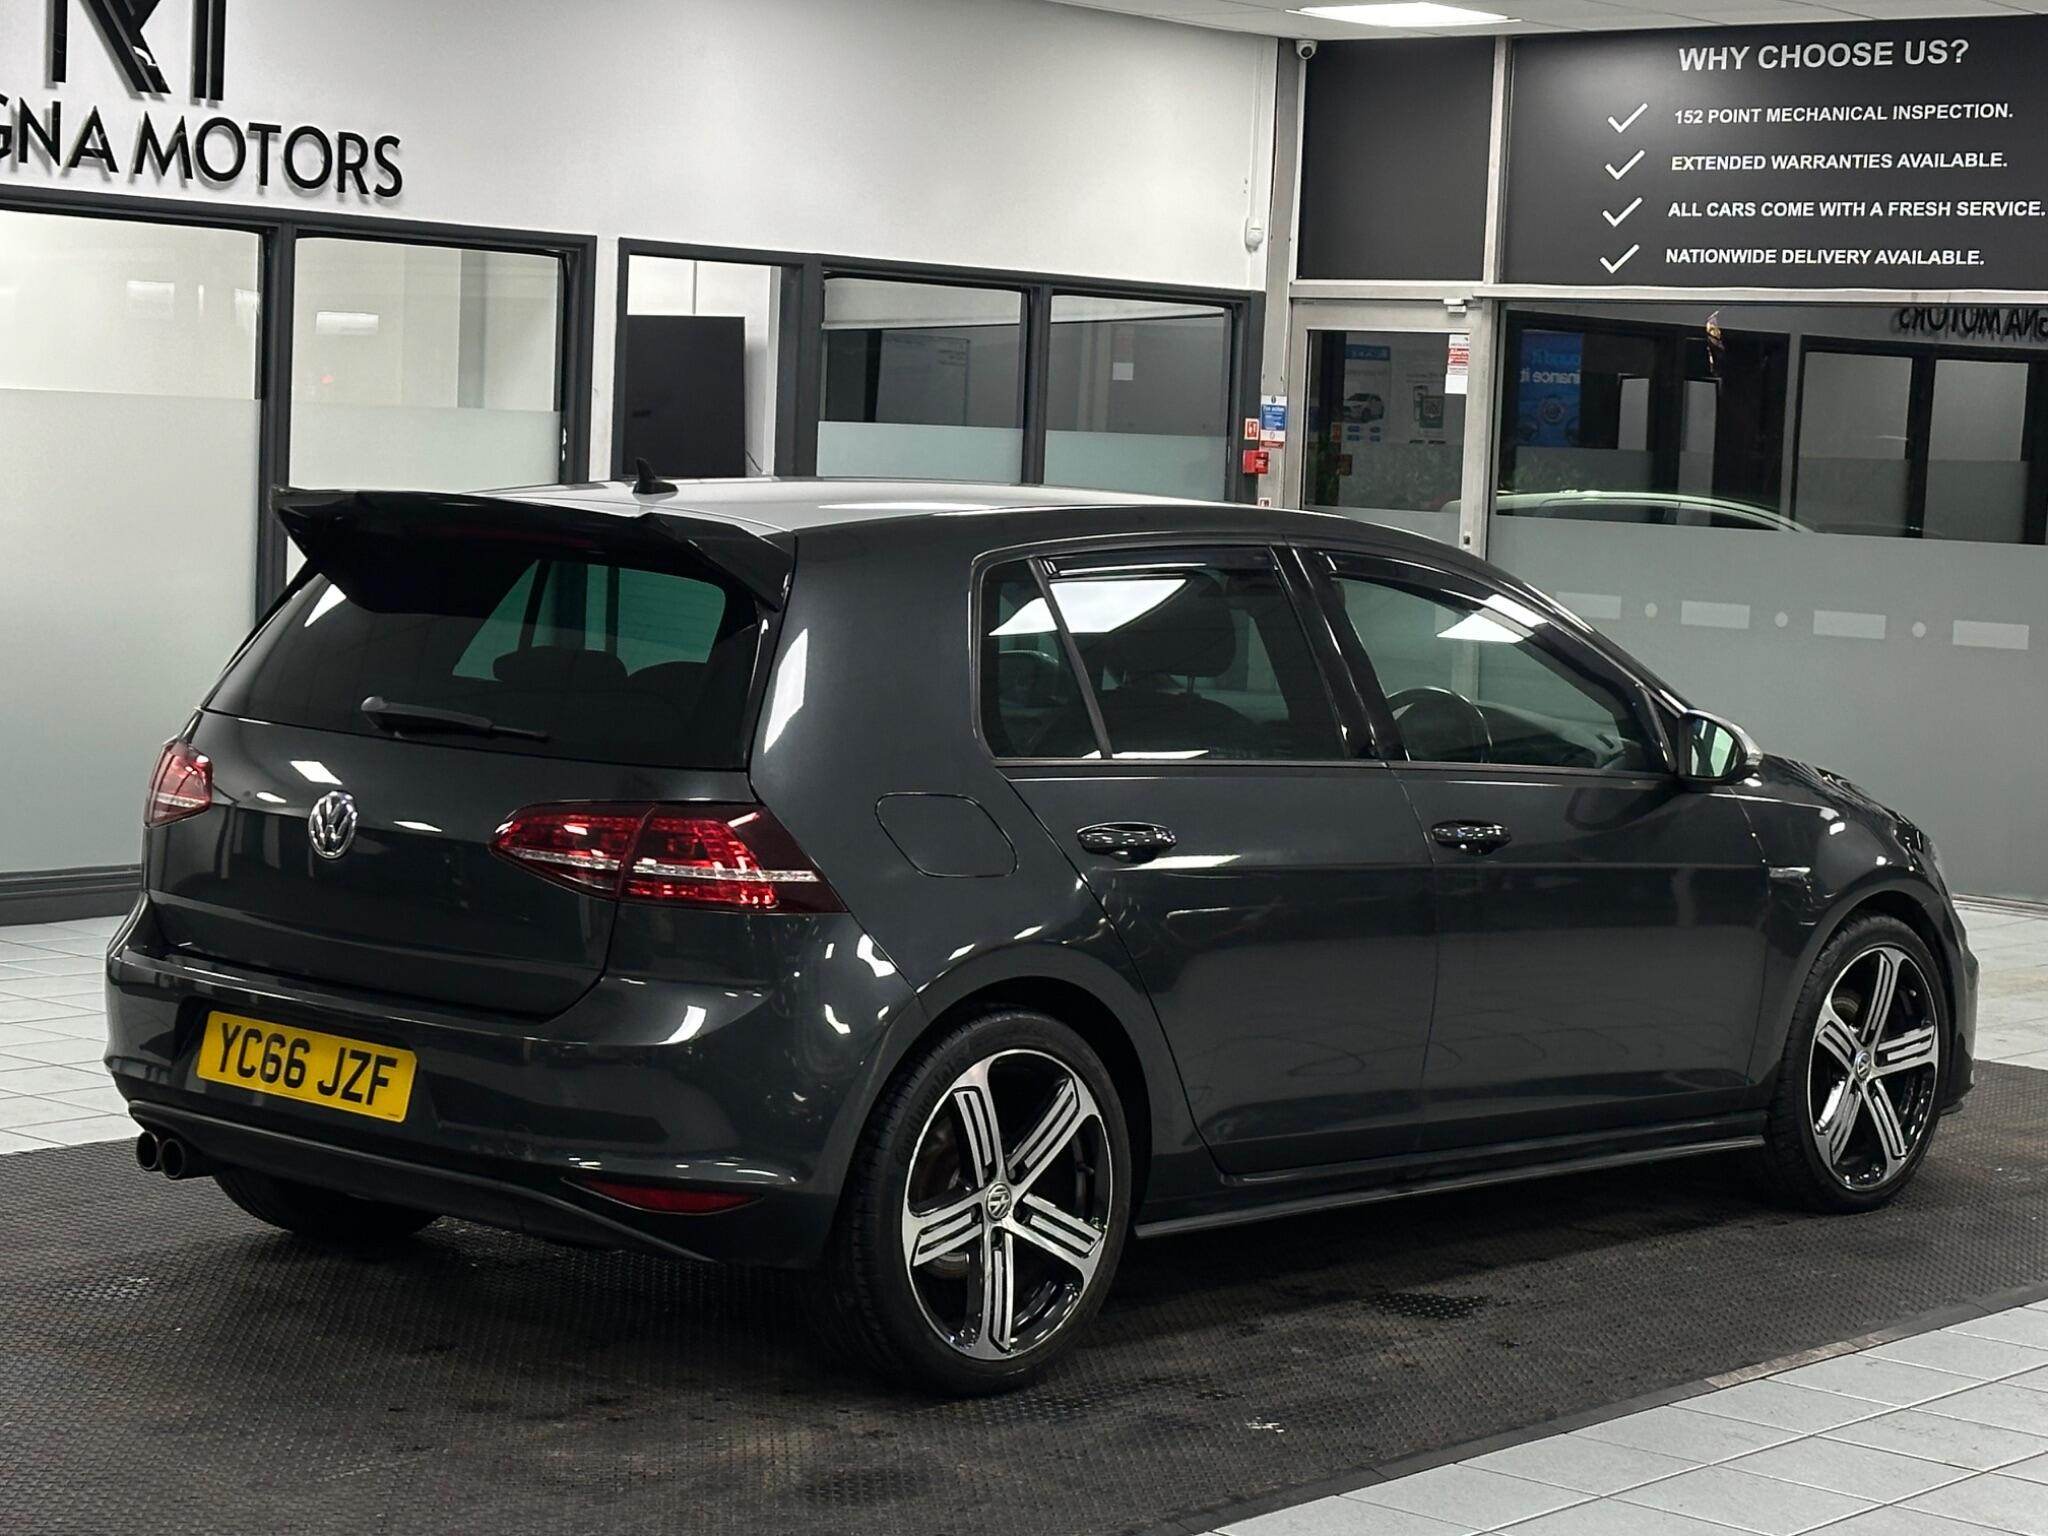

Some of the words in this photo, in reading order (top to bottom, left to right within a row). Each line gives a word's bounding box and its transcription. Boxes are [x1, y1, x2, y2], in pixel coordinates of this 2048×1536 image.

[1679, 47, 1751, 71] WHY
[1758, 41, 1894, 69] CHOOSE
[1905, 39, 1969, 64] US?
[1674, 109, 1704, 125] 152
[1708, 108, 1763, 124] POINT
[1766, 106, 1888, 123] MECHANICAL
[1892, 103, 2015, 120] INSPECTION.
[0, 93, 119, 173] NA
[134, 111, 402, 198] MOTORS
[1671, 155, 1767, 171] EXTENDED
[1771, 154, 1893, 170] WARRANTIES
[1896, 152, 2008, 169] AVAILABLE.
[1668, 202, 1703, 217] ALL
[1706, 202, 1756, 217] CARS
[1760, 201, 1815, 217] COME
[1819, 202, 1866, 217] WITH
[1869, 202, 1884, 217] A
[1887, 202, 1952, 217] FRESH
[1956, 201, 2046, 217] SERVICE.
[1665, 248, 1778, 264] NATIONWIDE
[1781, 249, 1872, 265] DELIVERY
[1874, 250, 1985, 266] AVAILABLE.
[219, 1022, 311, 1089] YC66
[317, 1046, 398, 1106] JZF
